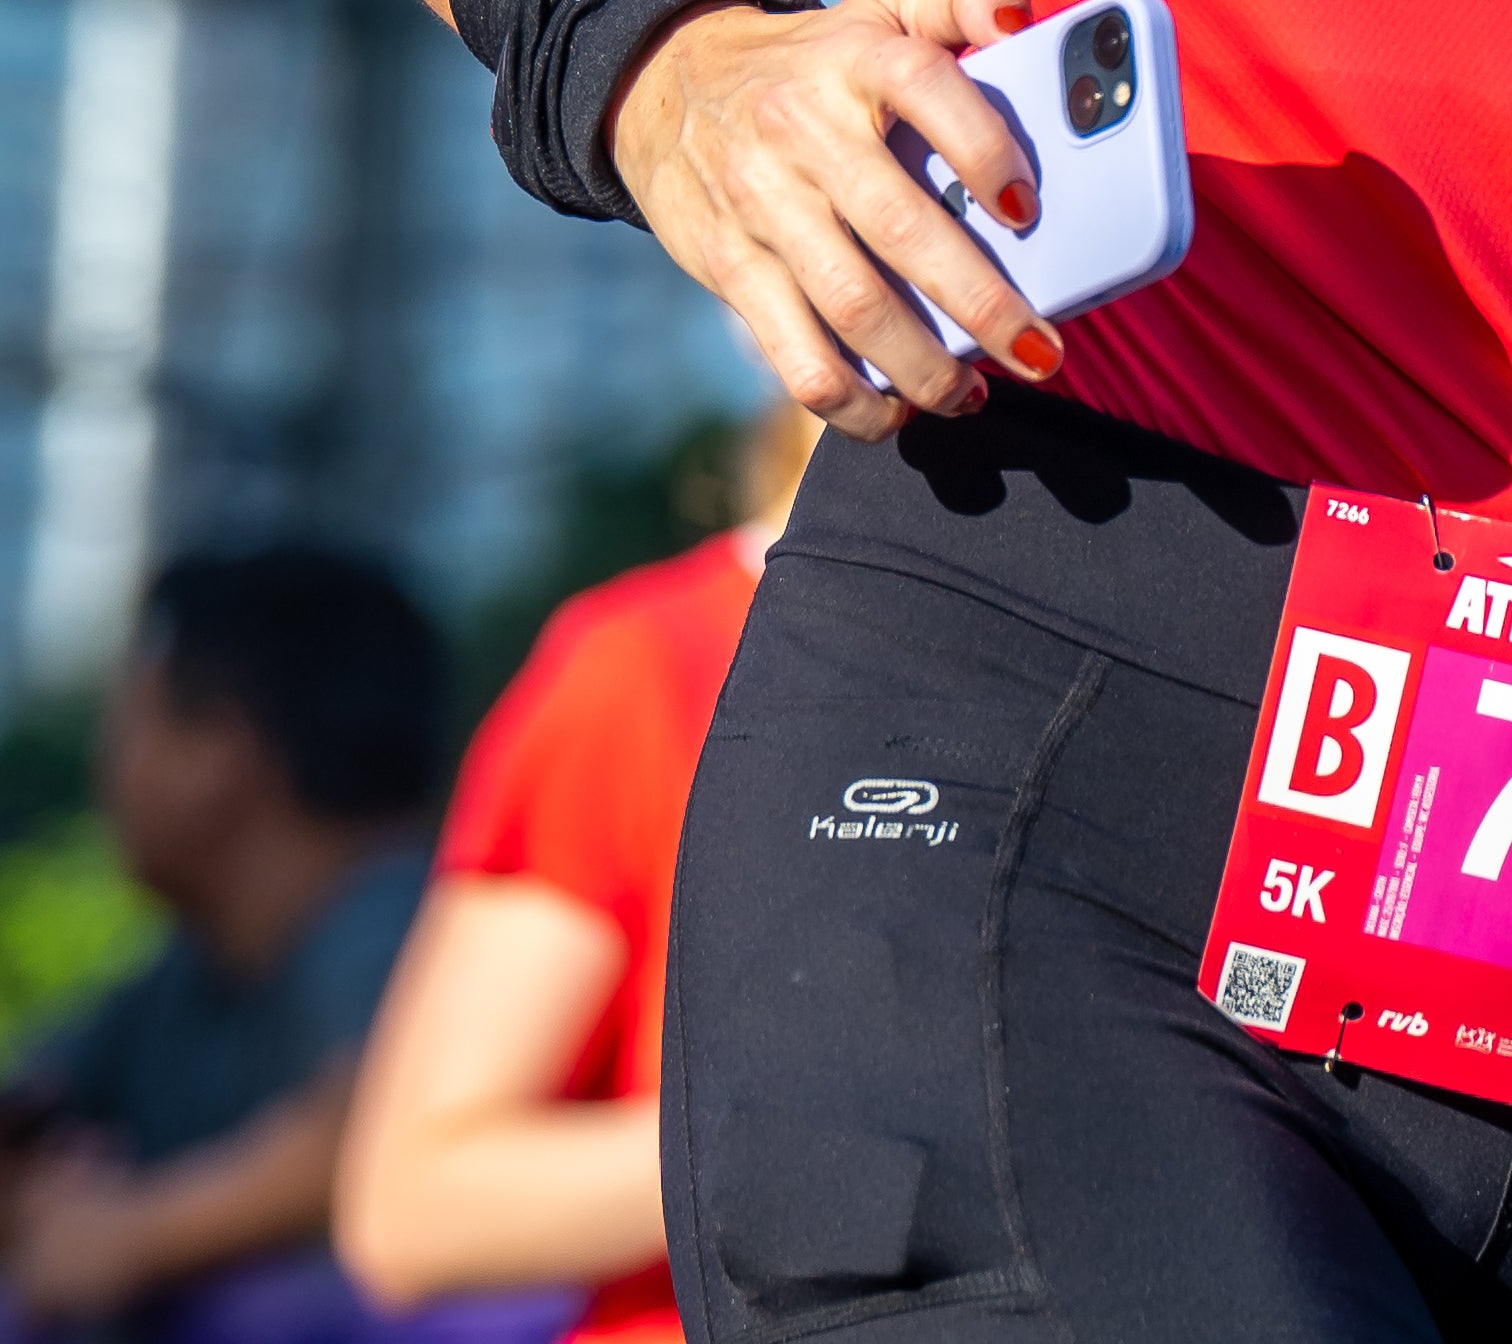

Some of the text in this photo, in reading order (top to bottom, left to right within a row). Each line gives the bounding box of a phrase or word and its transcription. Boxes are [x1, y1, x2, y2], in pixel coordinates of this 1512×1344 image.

[1327, 498, 1370, 526] 7266
[1288, 652, 1377, 798] B
[1260, 859, 1336, 924] 5K
